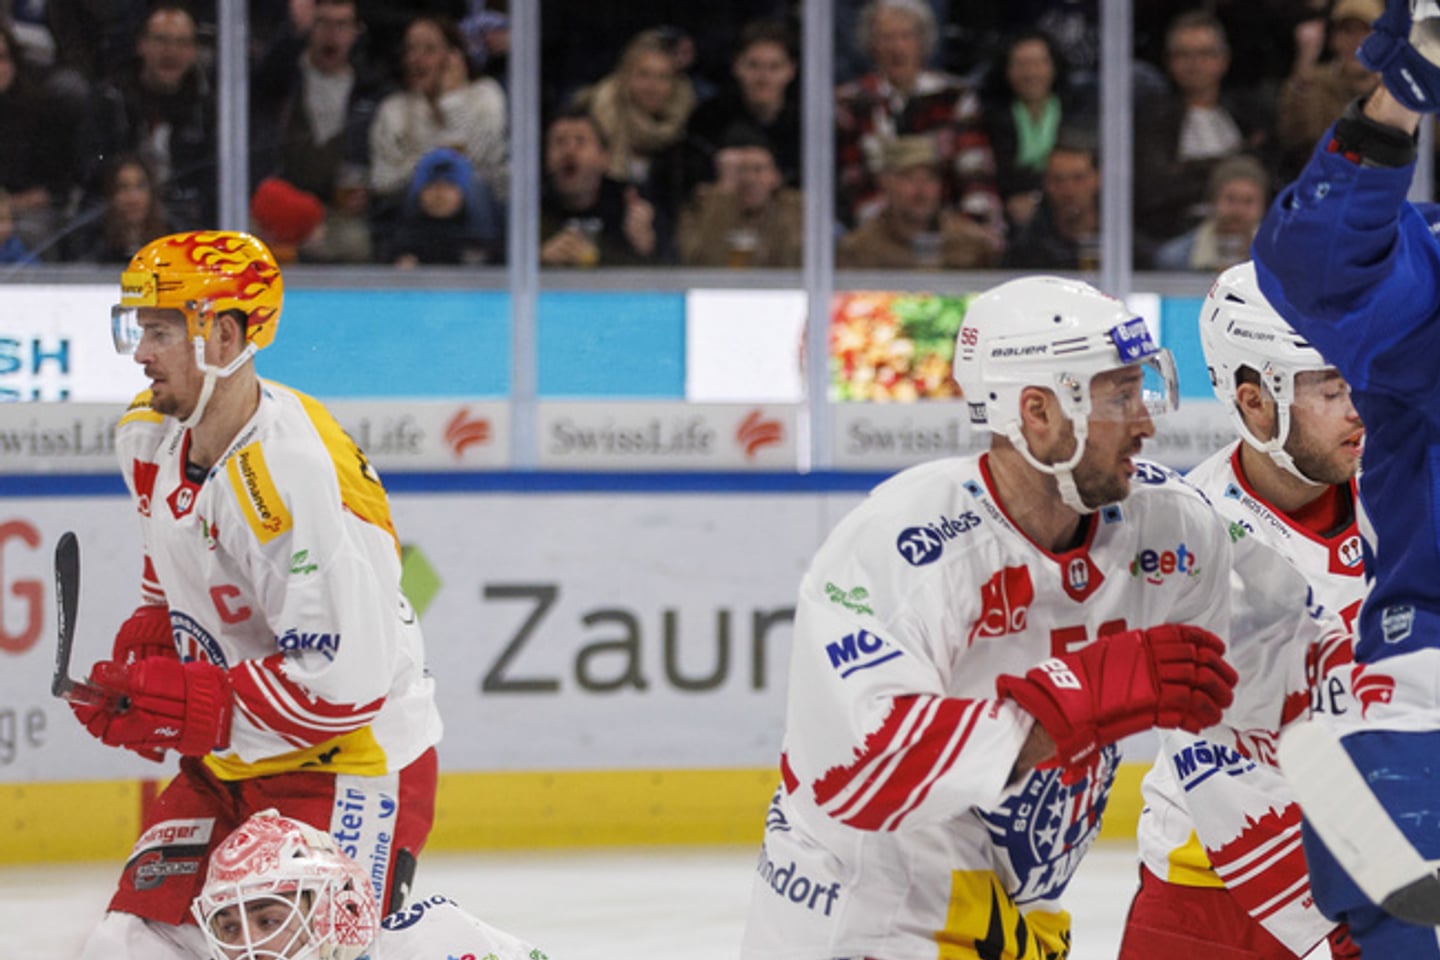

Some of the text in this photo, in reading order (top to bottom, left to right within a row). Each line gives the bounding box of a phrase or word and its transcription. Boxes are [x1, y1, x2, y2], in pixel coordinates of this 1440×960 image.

[961, 327, 979, 346] 56
[549, 414, 718, 457] SwissLife
[239, 451, 273, 520] PostFinance
[209, 584, 252, 625] C
